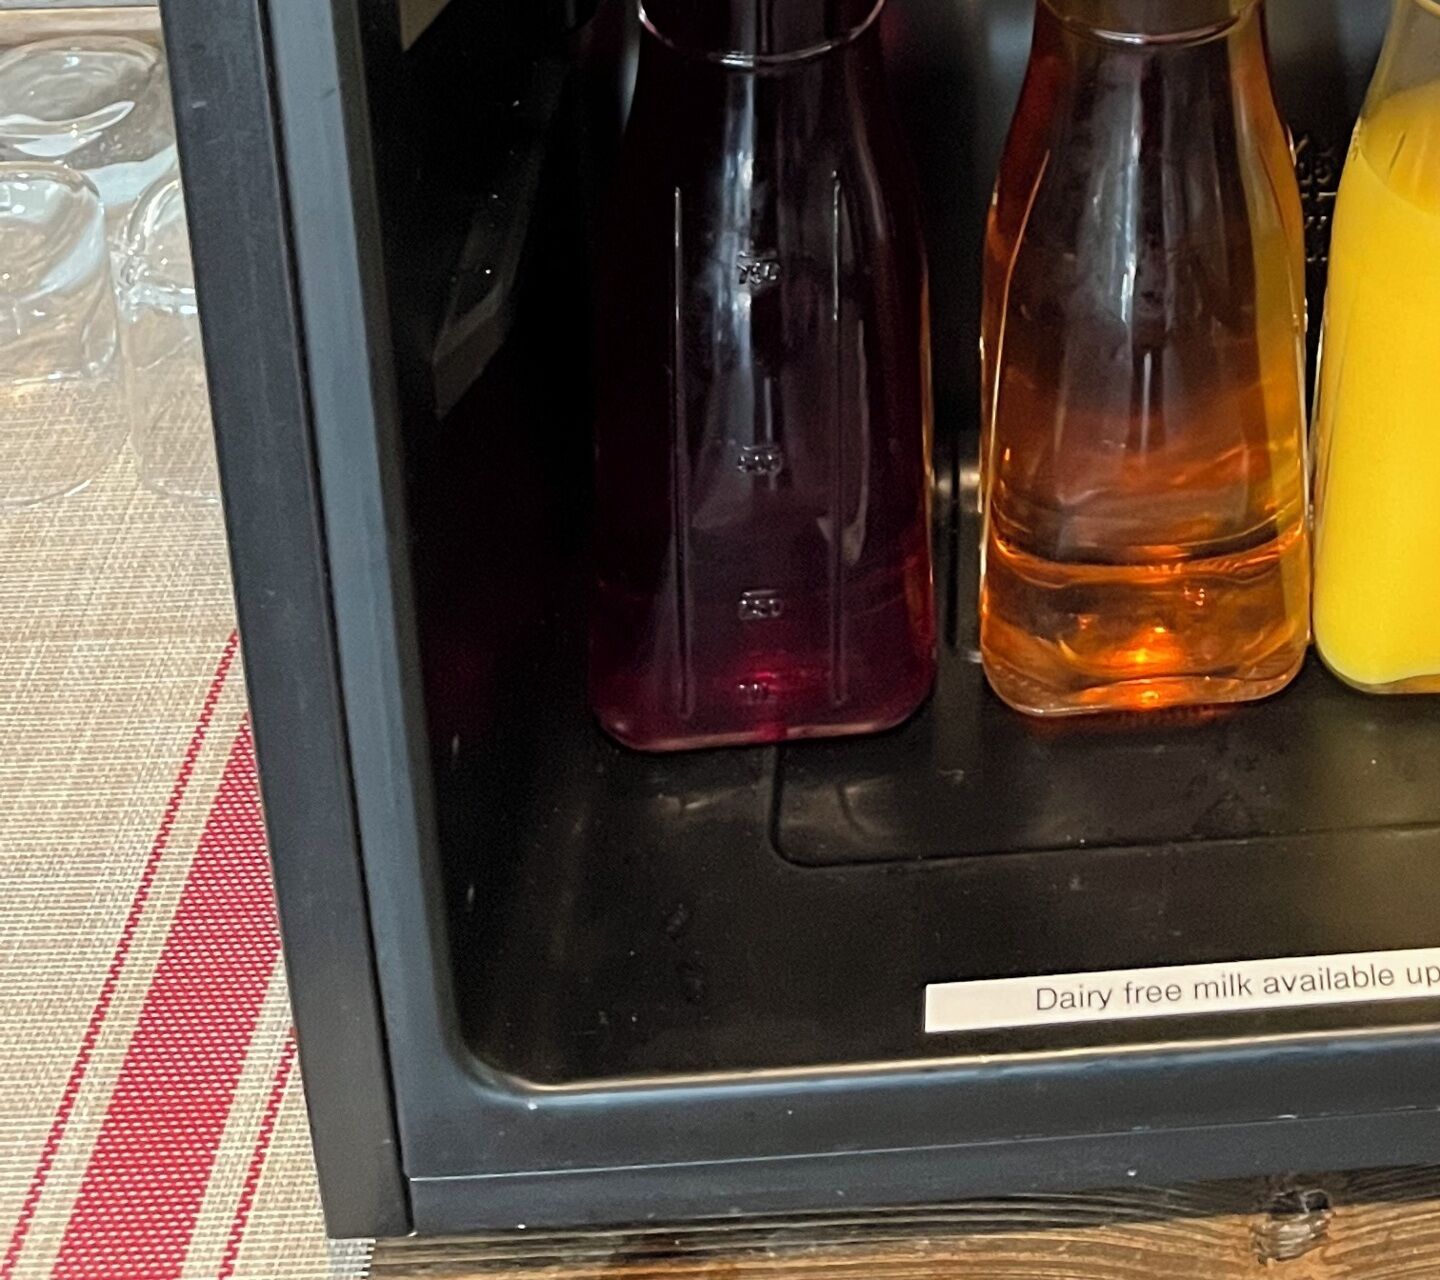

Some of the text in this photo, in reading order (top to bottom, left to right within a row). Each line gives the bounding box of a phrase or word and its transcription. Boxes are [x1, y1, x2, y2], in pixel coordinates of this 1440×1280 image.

[1036, 985, 1113, 1011] Dairy
[1125, 981, 1181, 1004] free
[1194, 973, 1252, 1000] milk
[1263, 963, 1395, 995] available
